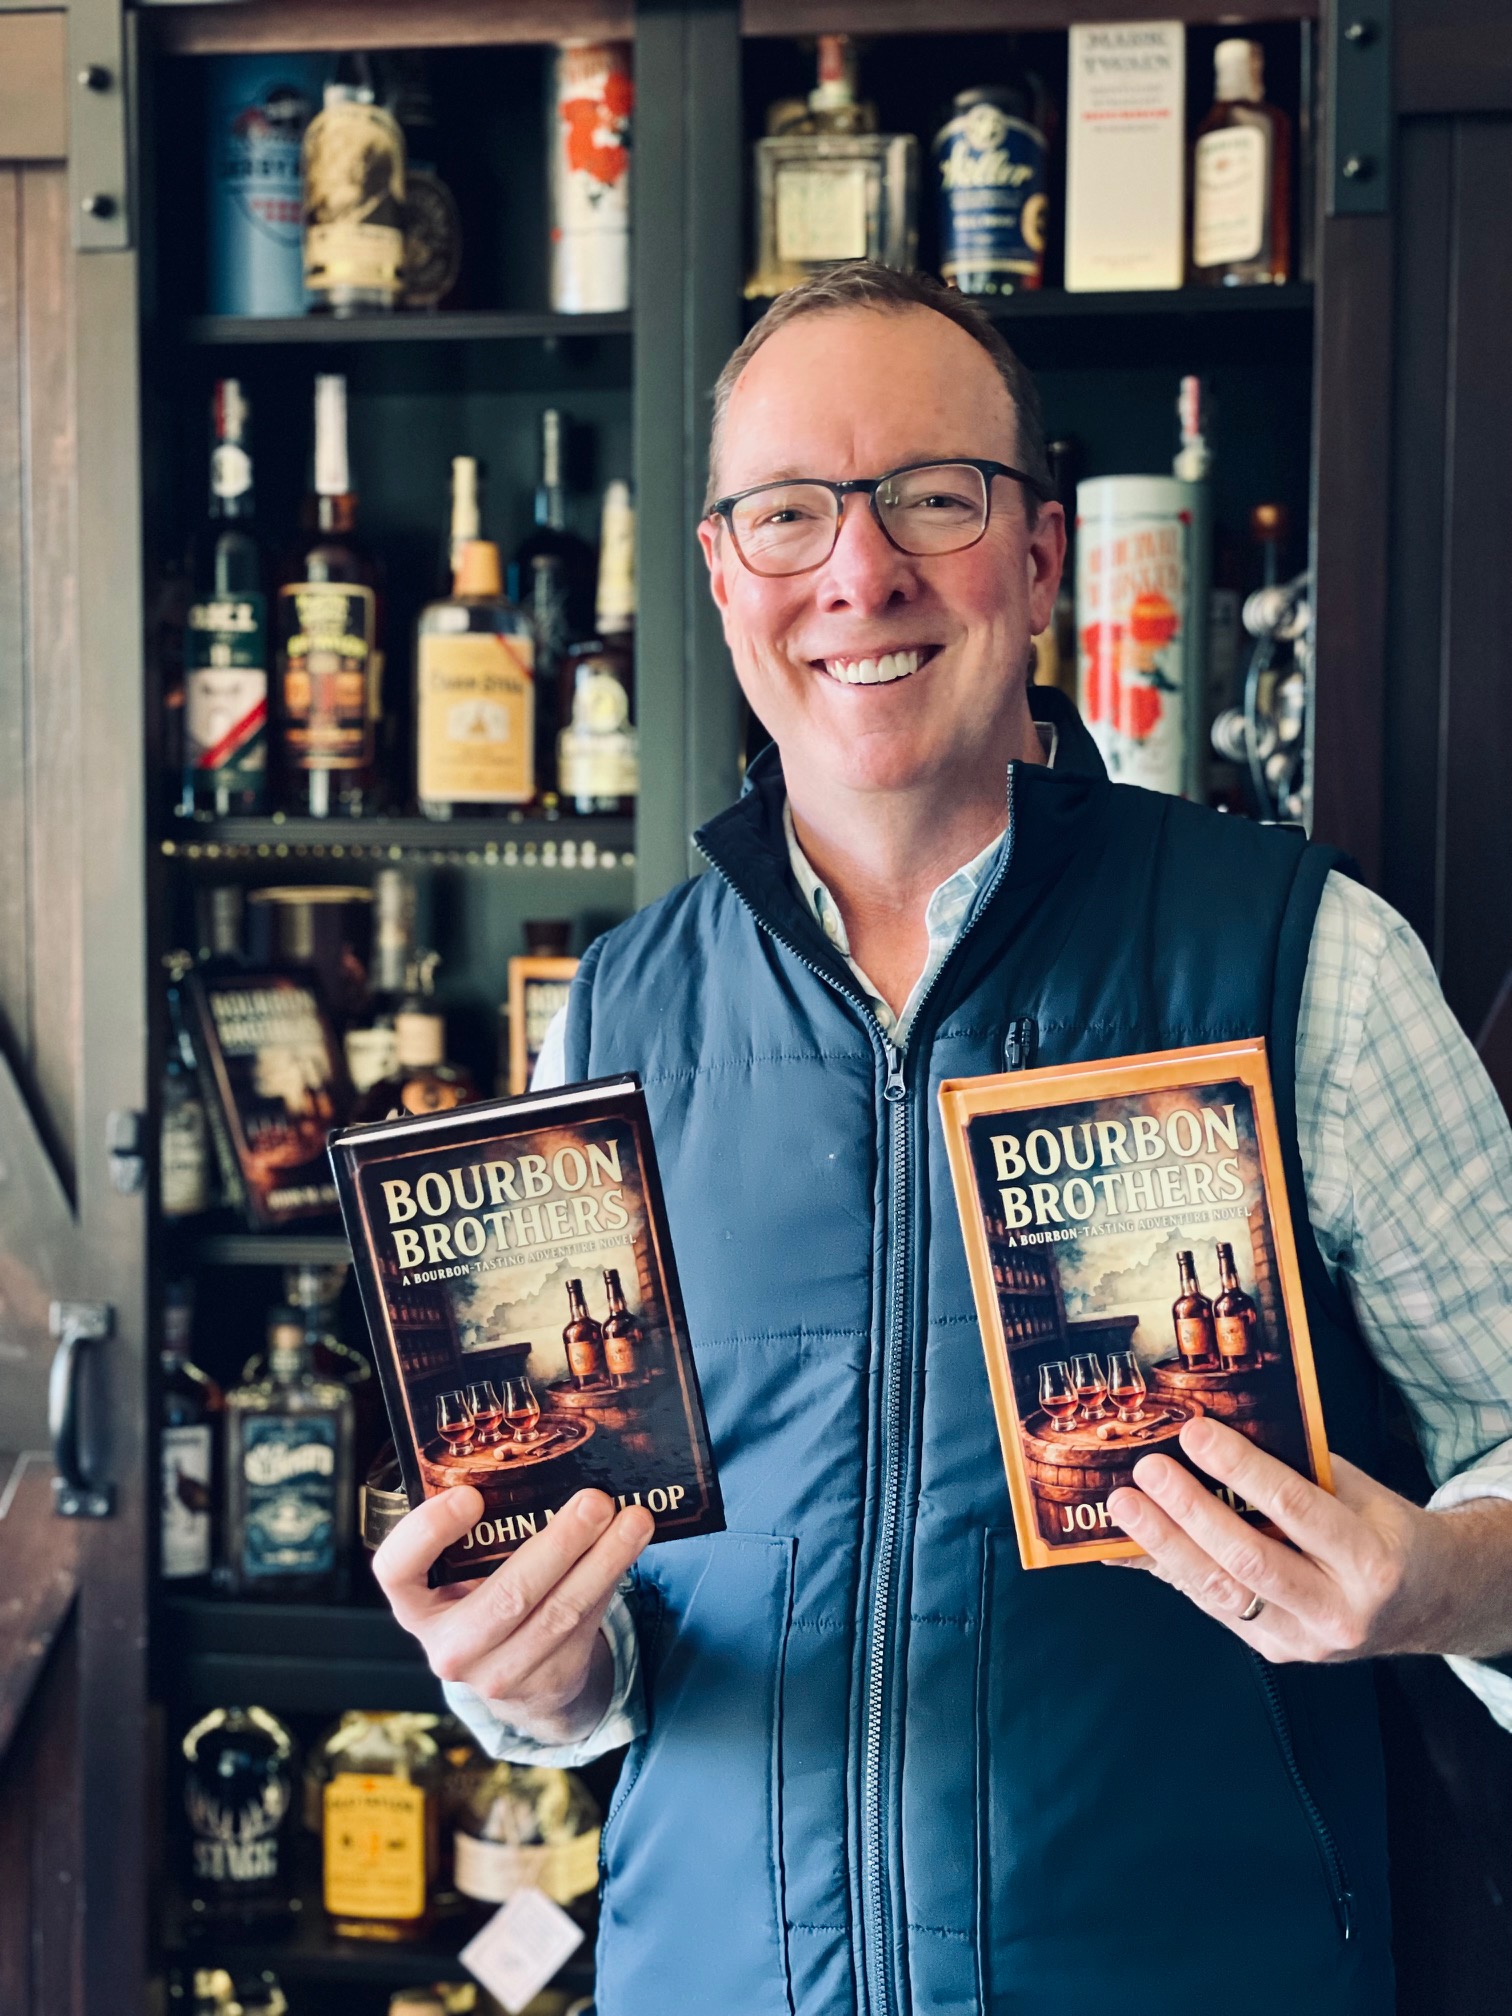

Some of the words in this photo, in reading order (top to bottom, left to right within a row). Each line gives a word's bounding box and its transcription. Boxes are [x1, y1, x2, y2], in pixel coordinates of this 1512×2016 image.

[990, 1104, 1239, 1181] BOURBON
[381, 1139, 623, 1224] BOURBON
[999, 1157, 1245, 1229] BROTHERS
[391, 1189, 629, 1270] BROTHERS
[1008, 1236, 1017, 1248] A
[1020, 1220, 1134, 1246] BOURBON-TASTING
[1138, 1211, 1209, 1231] ADVENTURE
[1211, 1206, 1252, 1222] NOVEL
[402, 1275, 411, 1286] A
[414, 1254, 525, 1284] BOURBON-TASTING
[527, 1241, 596, 1264] ADVENTURE
[598, 1234, 637, 1249] NOVEL
[463, 1512, 538, 1550] JOHN
[1062, 1501, 1121, 1533] JOH
